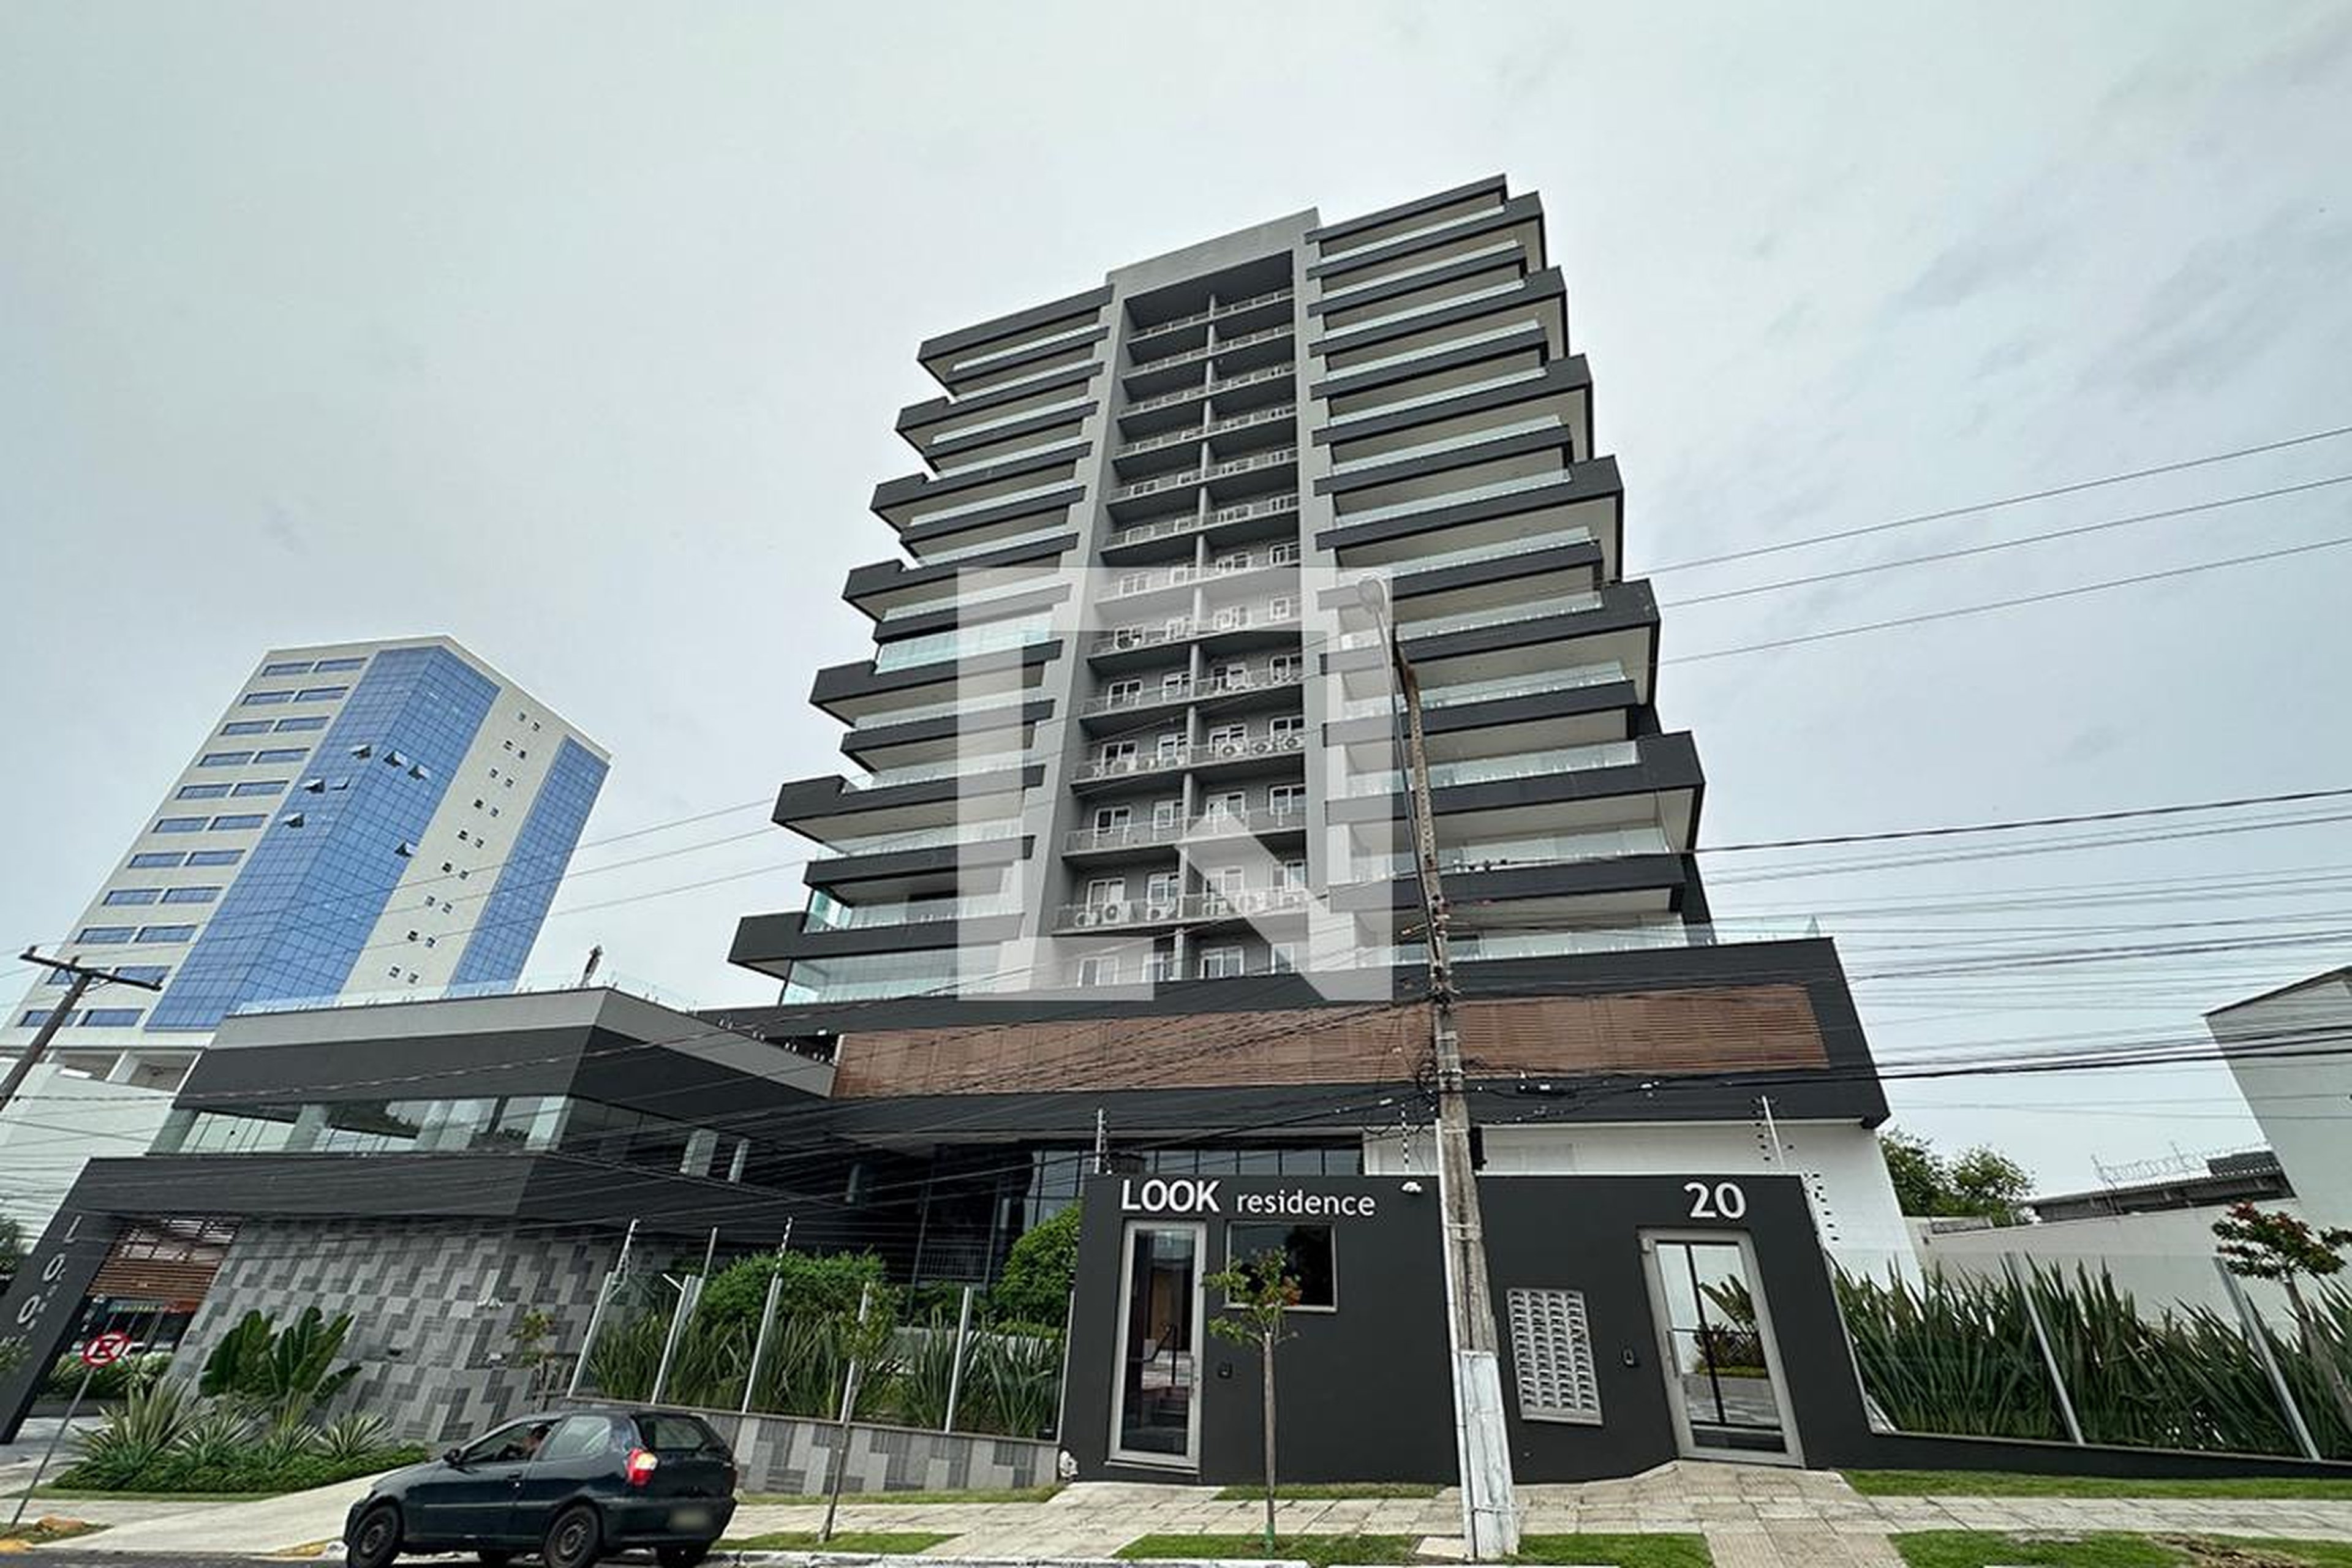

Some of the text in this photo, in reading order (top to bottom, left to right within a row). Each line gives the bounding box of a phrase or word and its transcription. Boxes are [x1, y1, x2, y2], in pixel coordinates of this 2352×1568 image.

[1121, 1179, 1376, 1216] LOOK residence
[1684, 1182, 1746, 1219] 20
